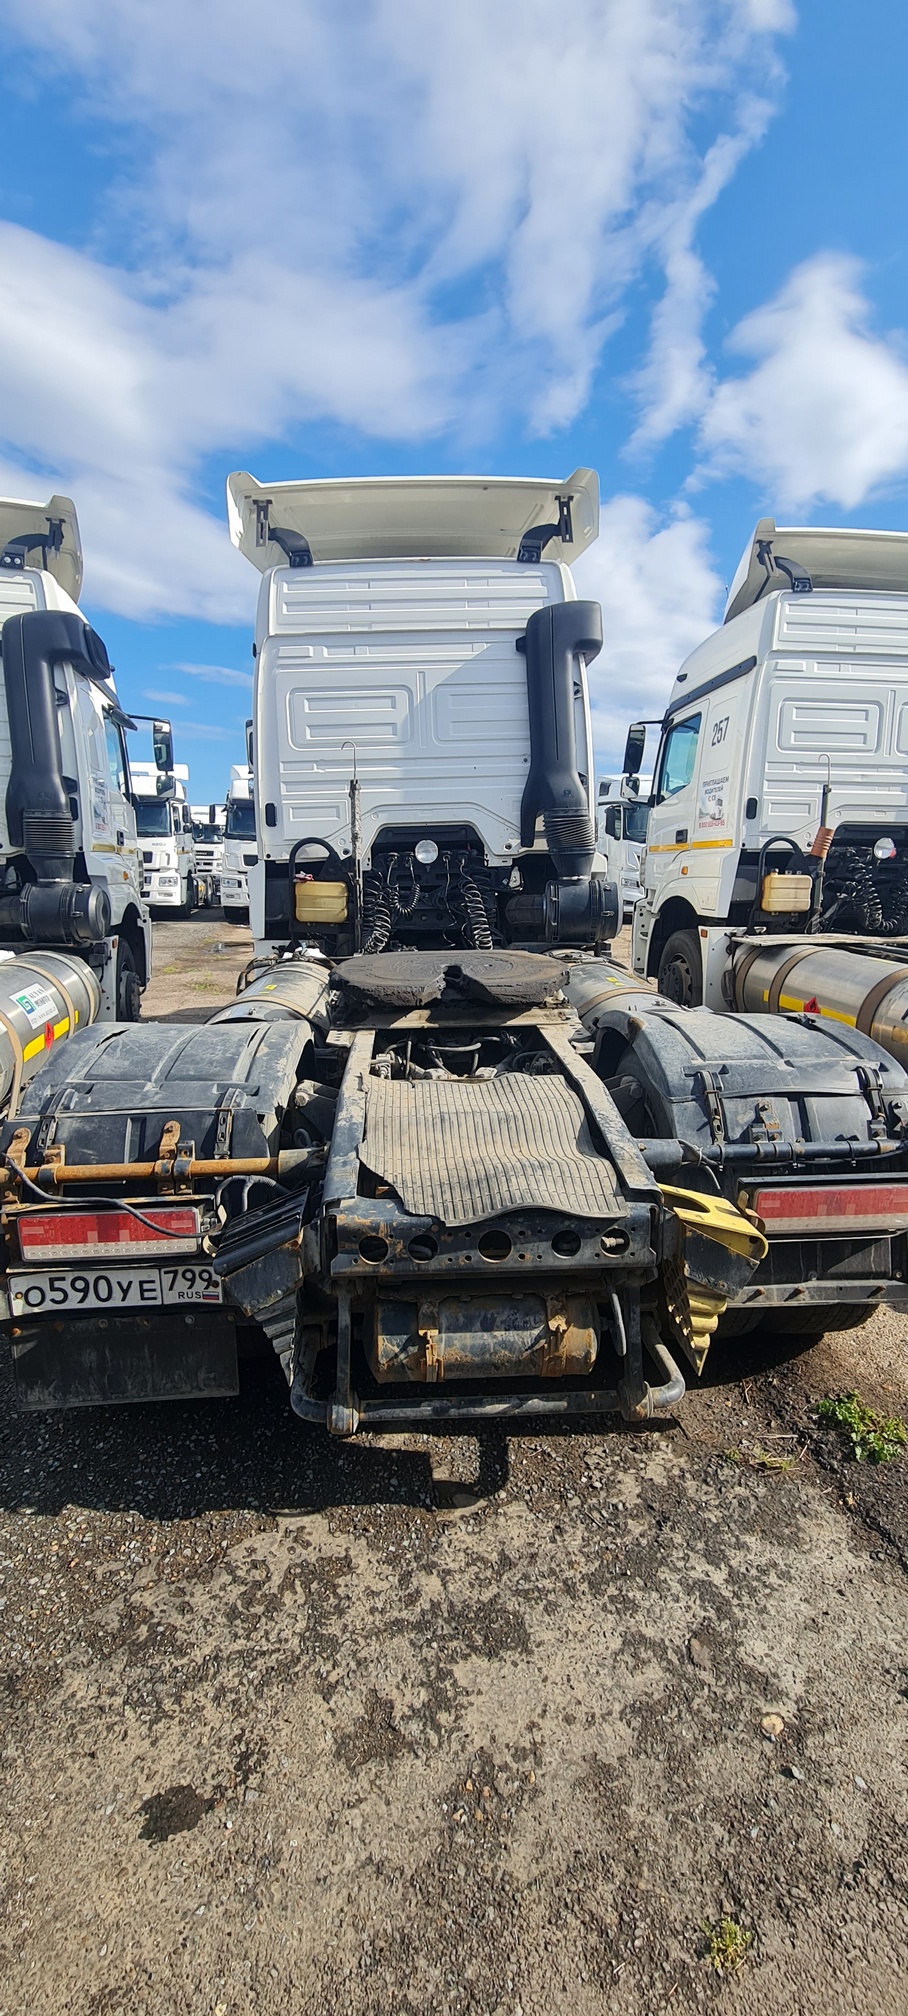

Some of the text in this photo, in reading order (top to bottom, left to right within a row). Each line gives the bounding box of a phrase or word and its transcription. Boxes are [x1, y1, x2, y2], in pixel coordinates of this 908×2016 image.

[711, 716, 730, 747] 257
[23, 1275, 158, 1308] О590УЕ
[164, 1268, 213, 1291] 799
[178, 1291, 202, 1300] RUS
